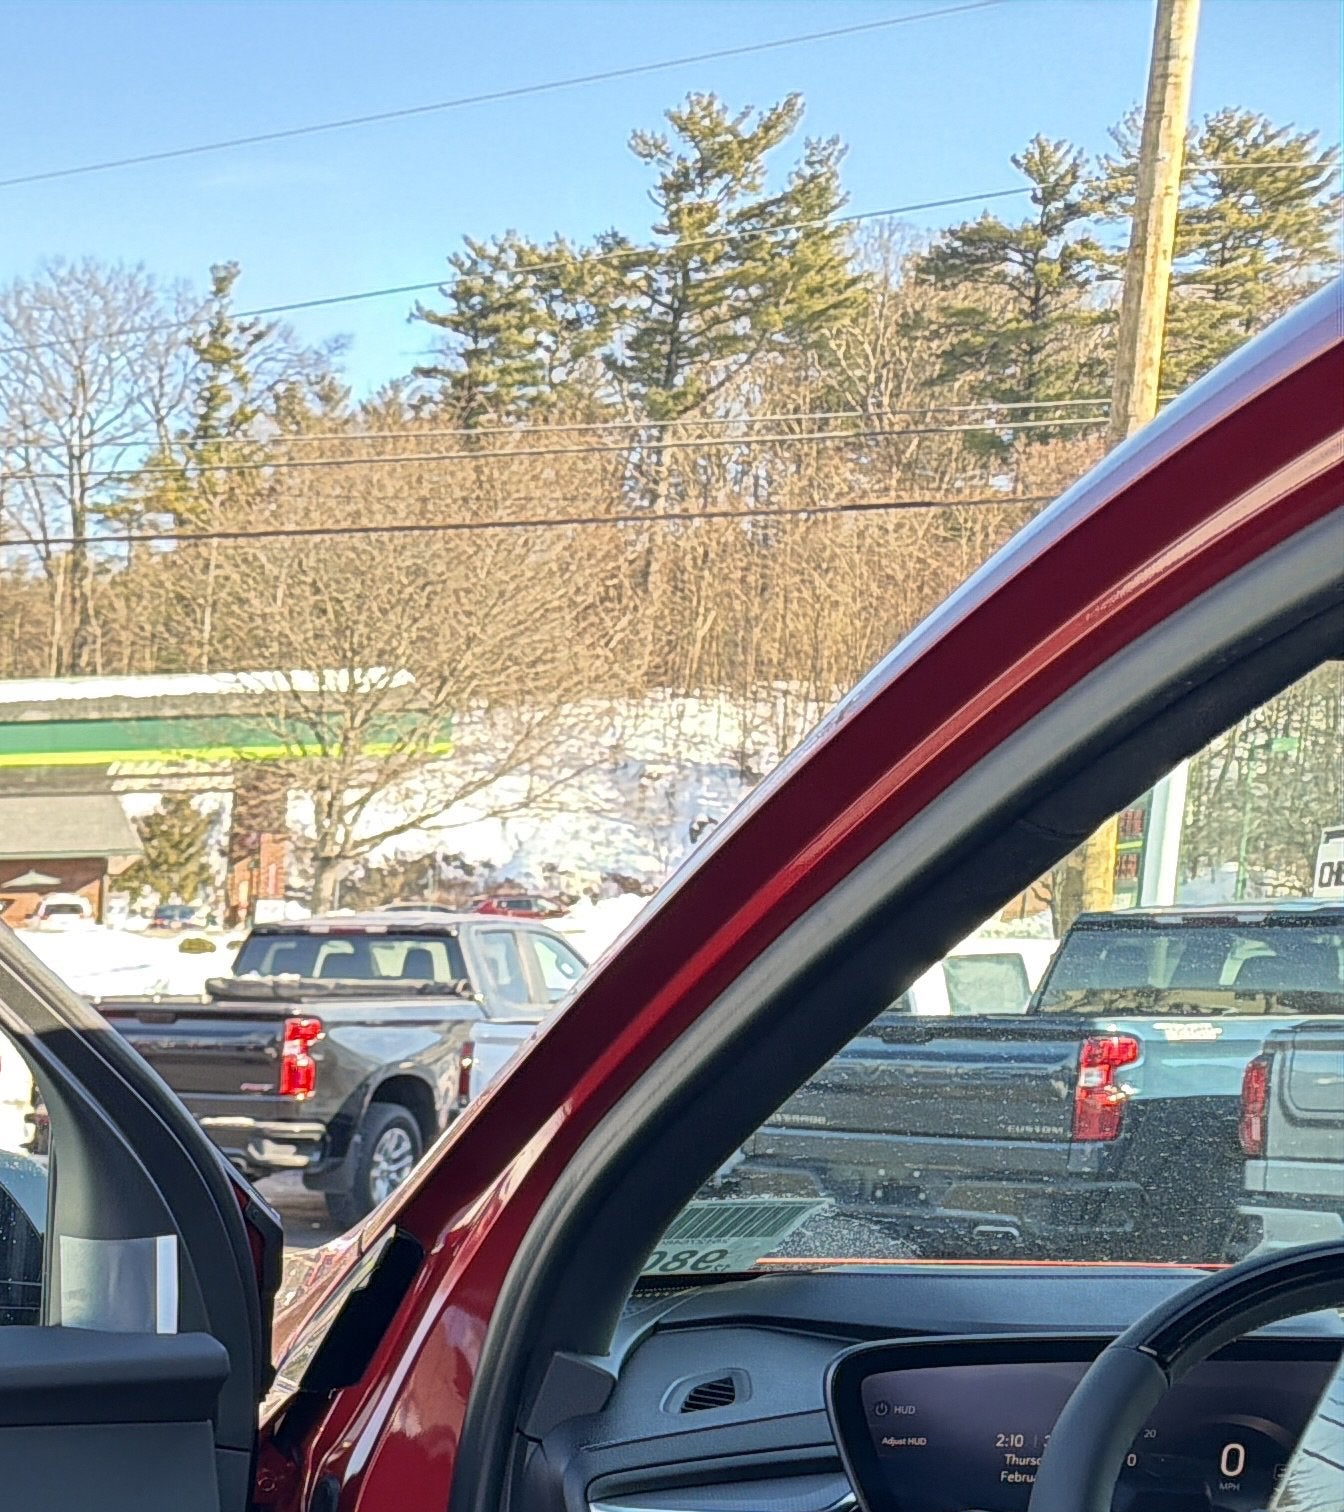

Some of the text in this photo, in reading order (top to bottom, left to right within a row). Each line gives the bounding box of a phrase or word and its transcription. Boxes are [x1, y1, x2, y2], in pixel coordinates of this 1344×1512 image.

[893, 1405, 916, 1415] HUD
[1143, 1429, 1157, 1438] 20
[881, 1436, 927, 1447] Adjust HUD
[995, 1433, 1024, 1448] 2:10
[1220, 1443, 1245, 1476] 0
[1000, 1470, 1036, 1483] Febru
[1218, 1482, 1240, 1492] MPH
